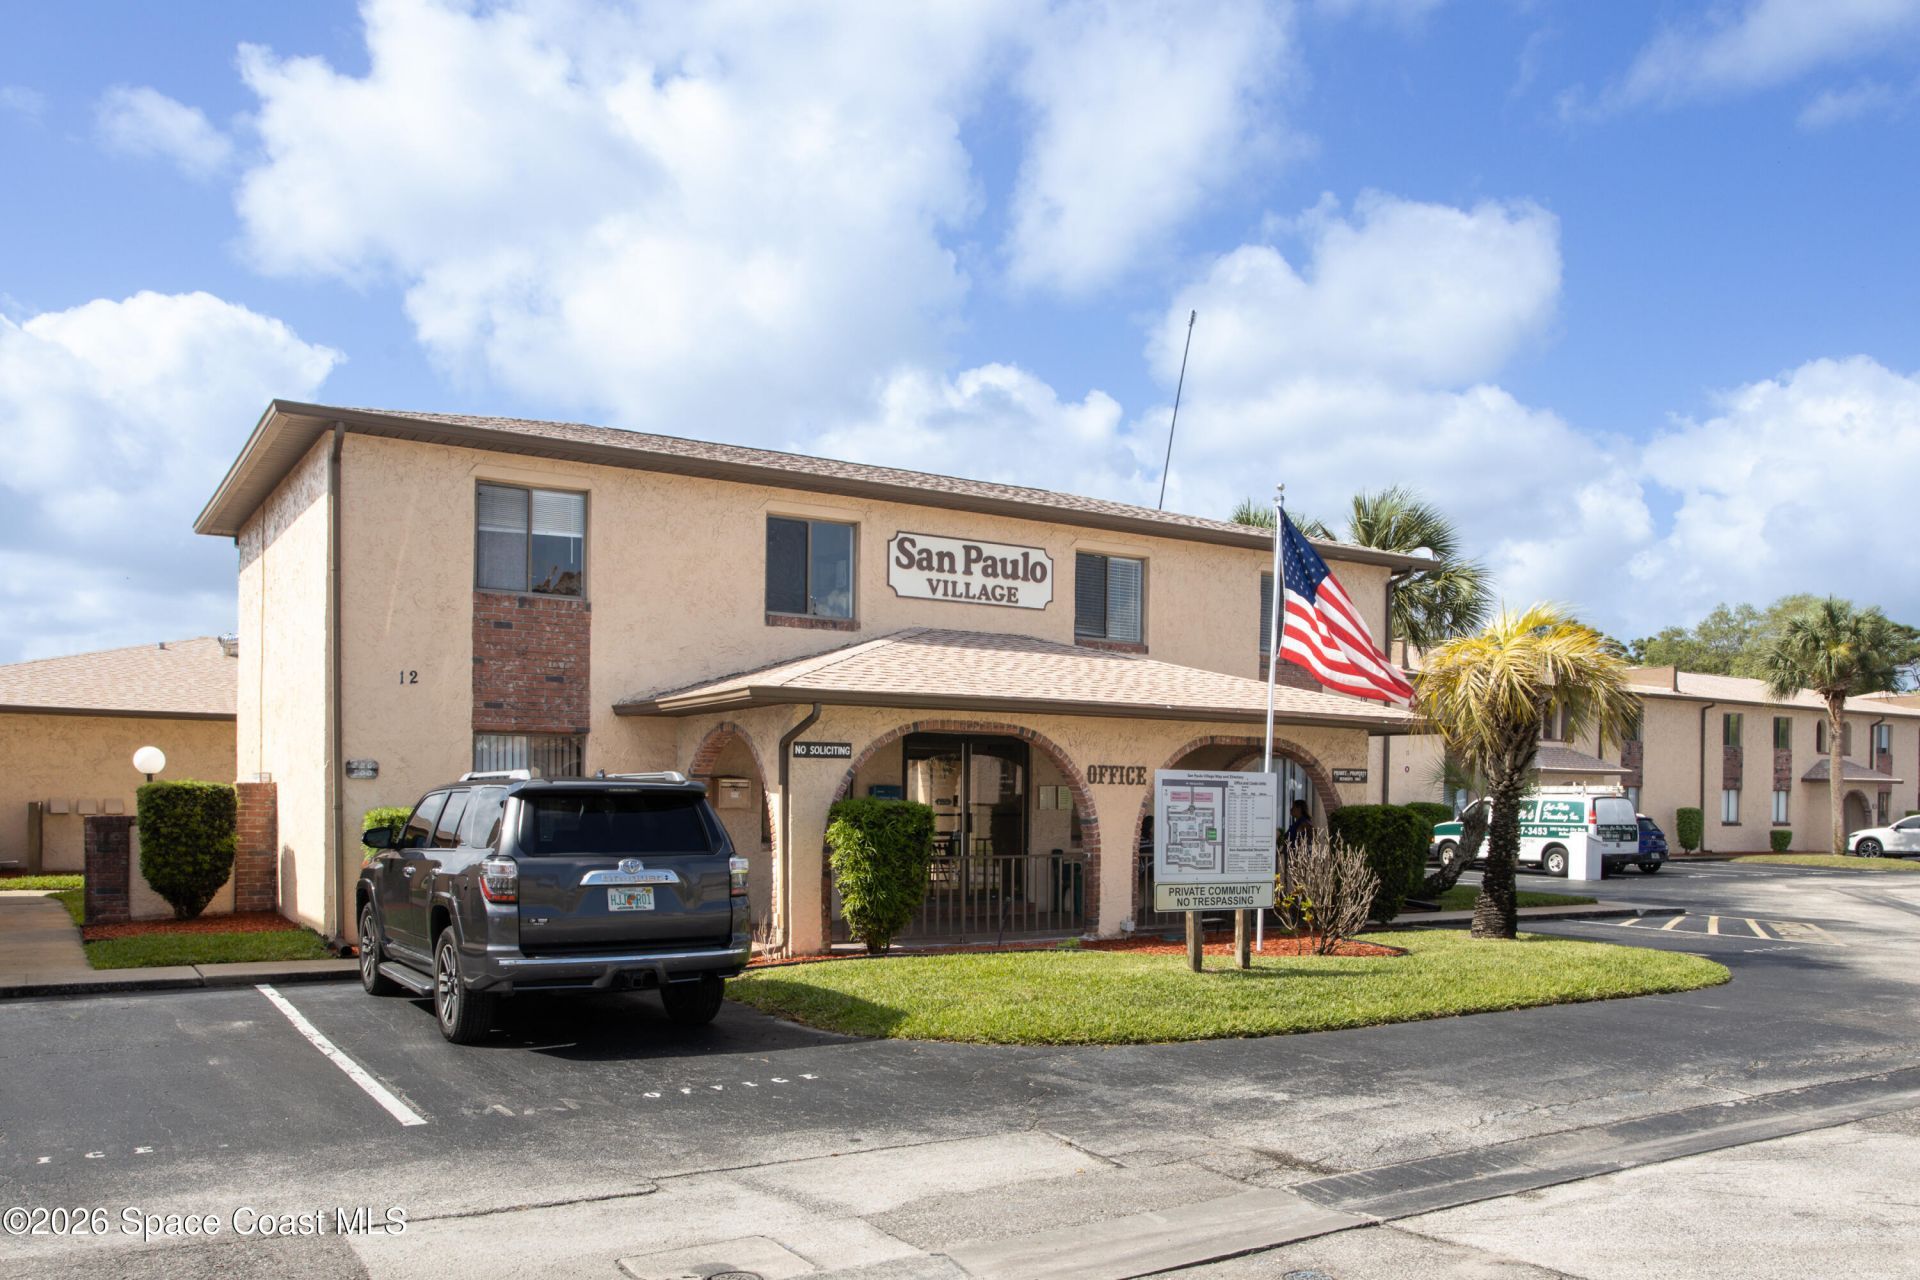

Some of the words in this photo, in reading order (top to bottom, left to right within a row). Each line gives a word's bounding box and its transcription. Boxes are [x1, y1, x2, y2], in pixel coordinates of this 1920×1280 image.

[895, 537, 957, 574] San
[962, 545, 1047, 583] Paulo
[926, 578, 1018, 603] VILLAGE
[399, 670, 419, 685] 12
[794, 745, 807, 755] NO
[809, 745, 851, 756] SOLICITING
[1087, 764, 1147, 786] OFFICE
[1519, 827, 1548, 836] 7-3453
[1168, 886, 1206, 897] PRIVATE
[1208, 885, 1261, 896] COMMUNITY
[1176, 898, 1191, 907] NO
[1193, 897, 1254, 907] TRESPASSING
